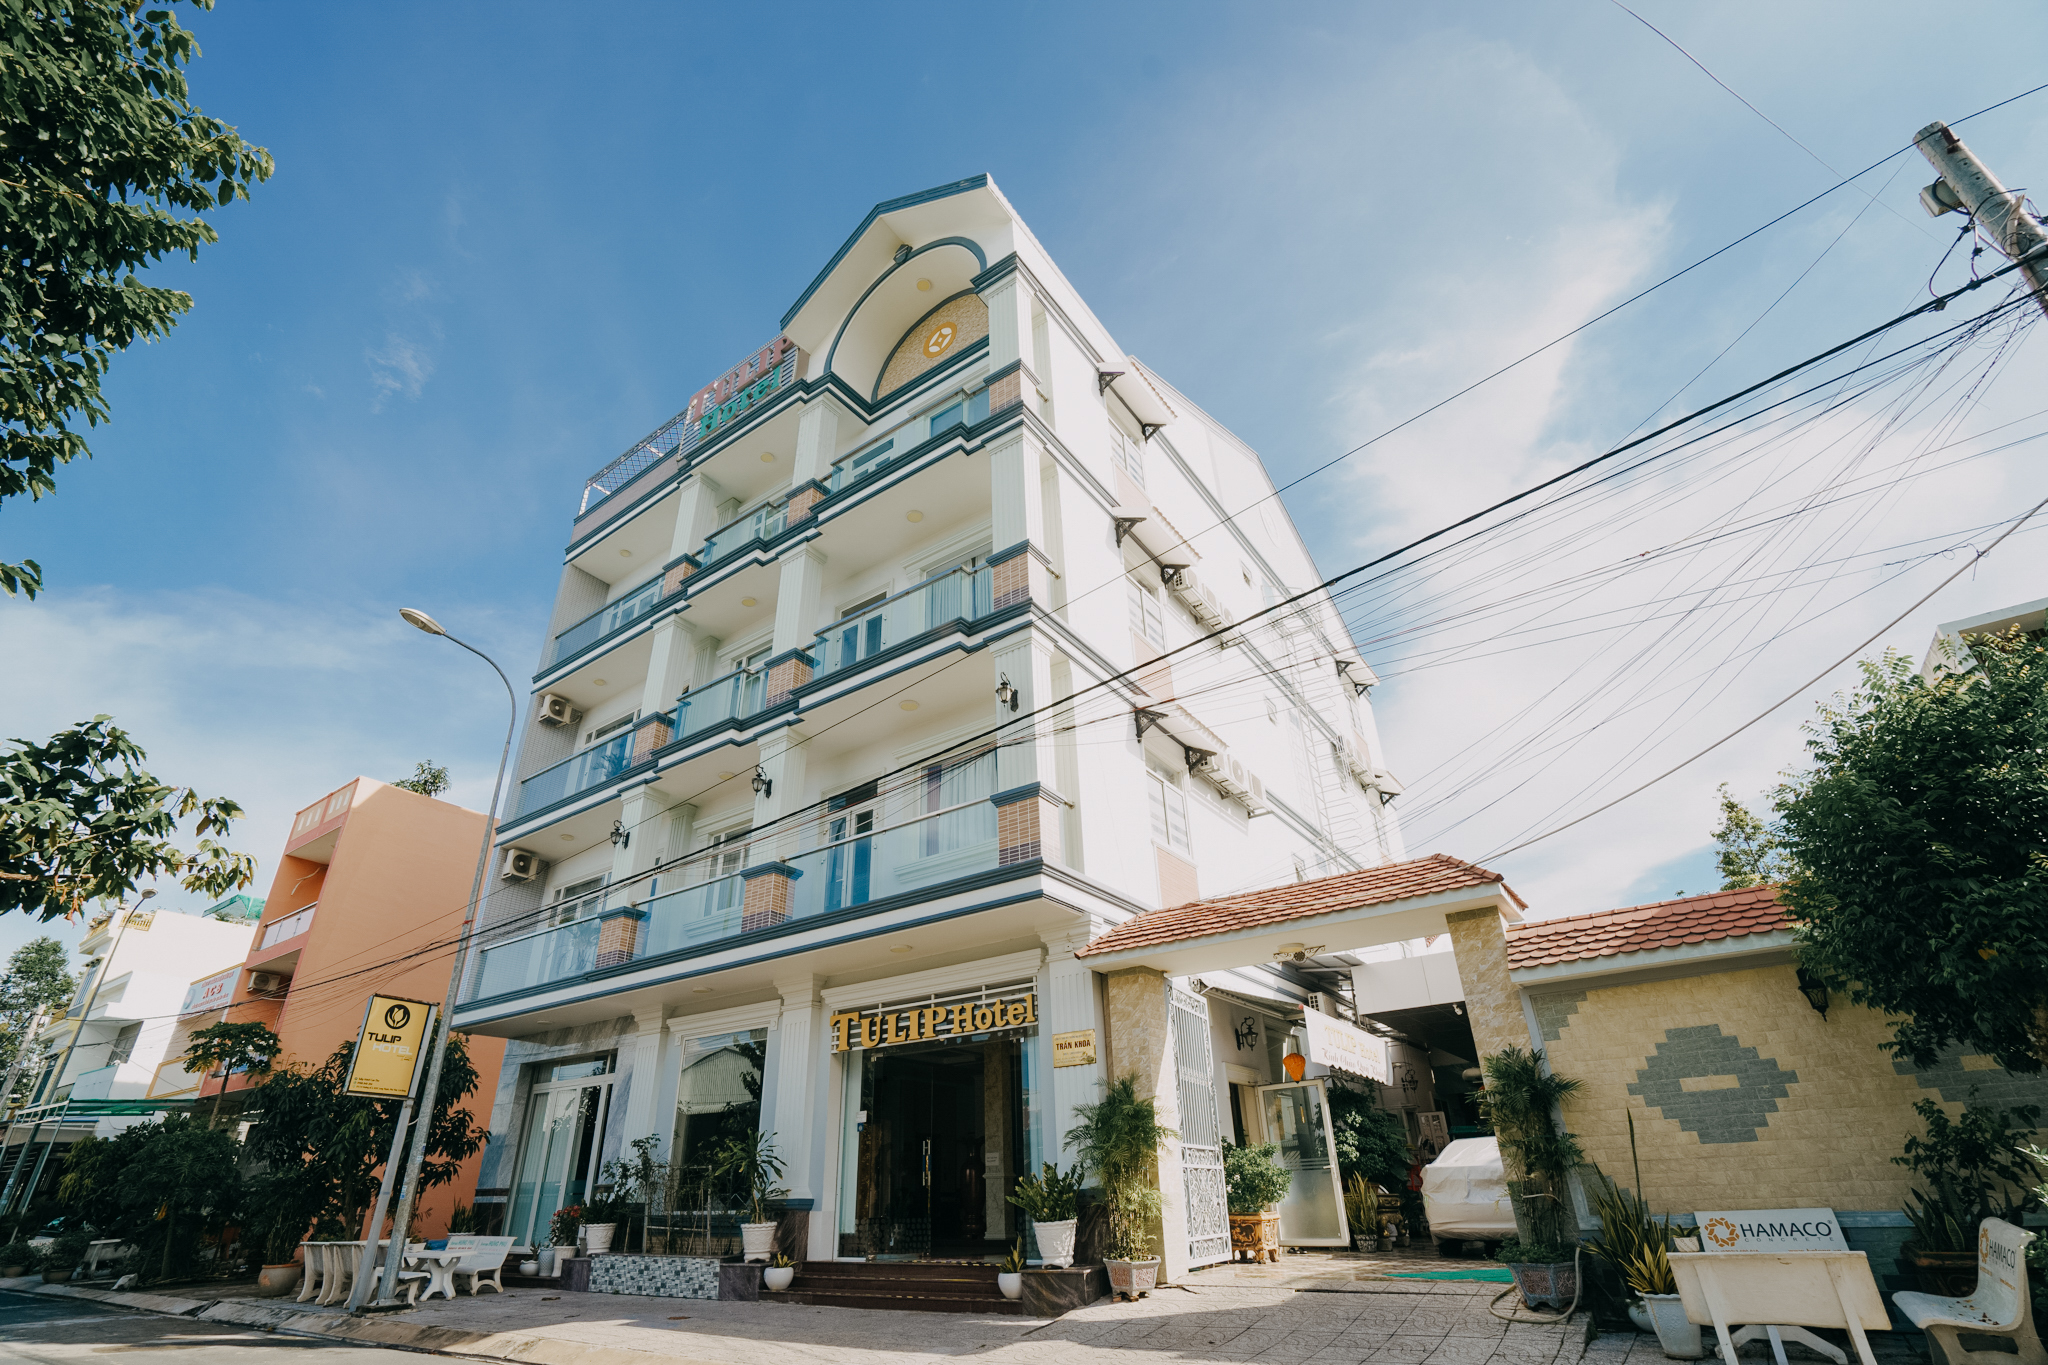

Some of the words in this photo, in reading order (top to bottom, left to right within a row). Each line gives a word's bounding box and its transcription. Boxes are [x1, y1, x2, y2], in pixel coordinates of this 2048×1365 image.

[690, 337, 794, 424] TULIP
[697, 364, 782, 441] Hotel
[368, 1031, 402, 1043] TULIP
[830, 1005, 948, 1052] TULIP
[950, 992, 1037, 1034] Hotel
[372, 1042, 412, 1056] HOTEL
[1074, 1039, 1091, 1049] KHOA
[1323, 1024, 1357, 1055] TULIP
[1739, 1221, 1832, 1238] HAMACO
[1989, 1239, 2016, 1269] HAMACO
